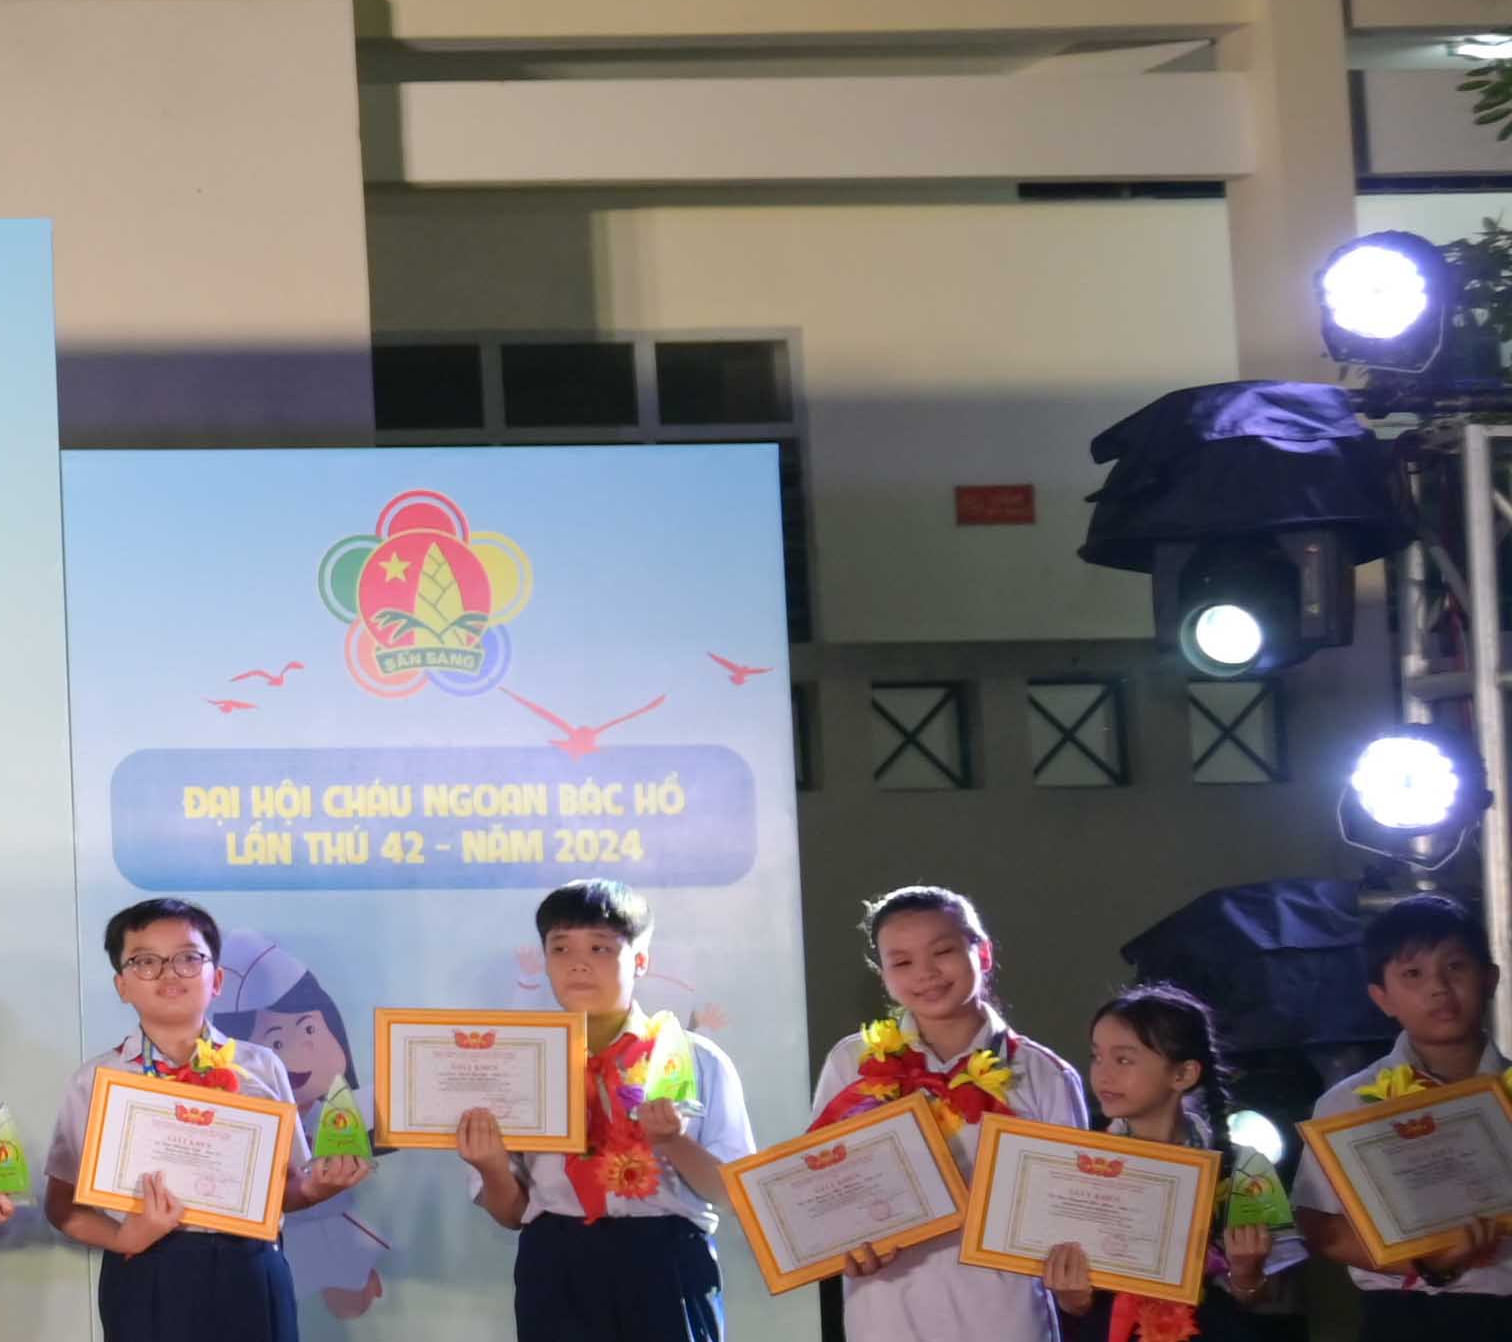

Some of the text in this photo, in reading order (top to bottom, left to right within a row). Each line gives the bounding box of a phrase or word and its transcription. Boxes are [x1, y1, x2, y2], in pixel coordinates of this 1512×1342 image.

[183, 770, 684, 824] ĐẠI HỘI CHÁU NGOAN BÁC HỒ
[226, 821, 292, 865] LẦN
[305, 827, 368, 864] THỨ
[381, 831, 425, 862] 42
[462, 824, 543, 863] NĂM
[555, 830, 644, 861] 2024
